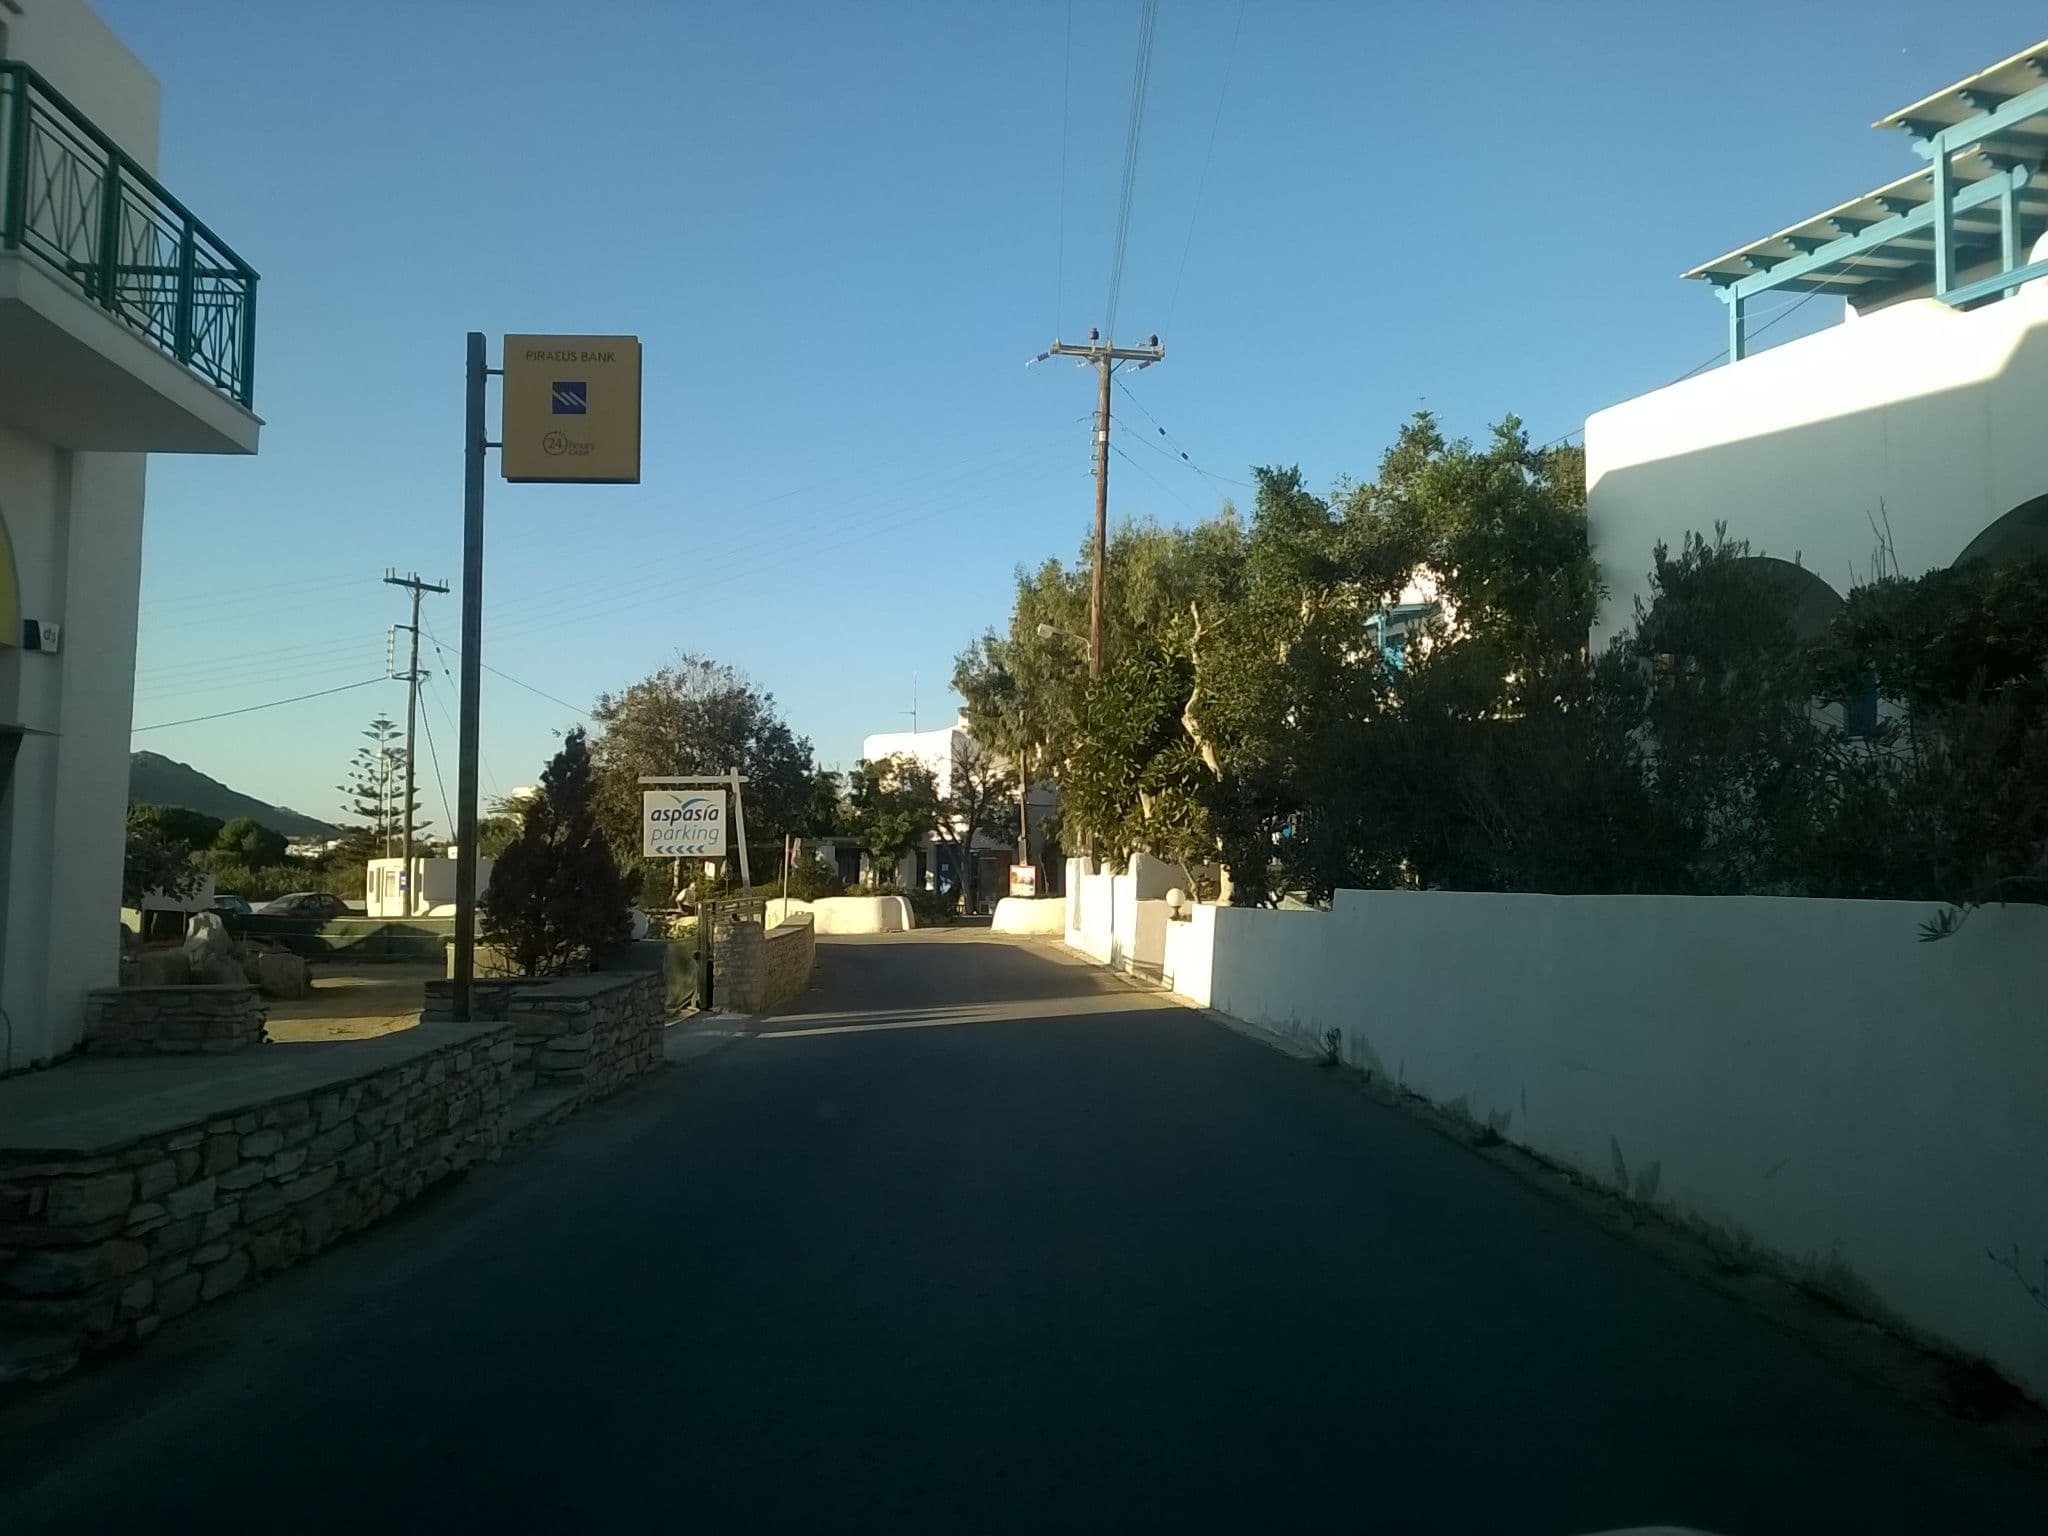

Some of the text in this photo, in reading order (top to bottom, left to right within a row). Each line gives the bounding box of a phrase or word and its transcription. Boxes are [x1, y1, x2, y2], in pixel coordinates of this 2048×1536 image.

[526, 351, 617, 363] PIRAEUS BANK
[548, 437, 562, 449] 24
[651, 825, 720, 846] parking
